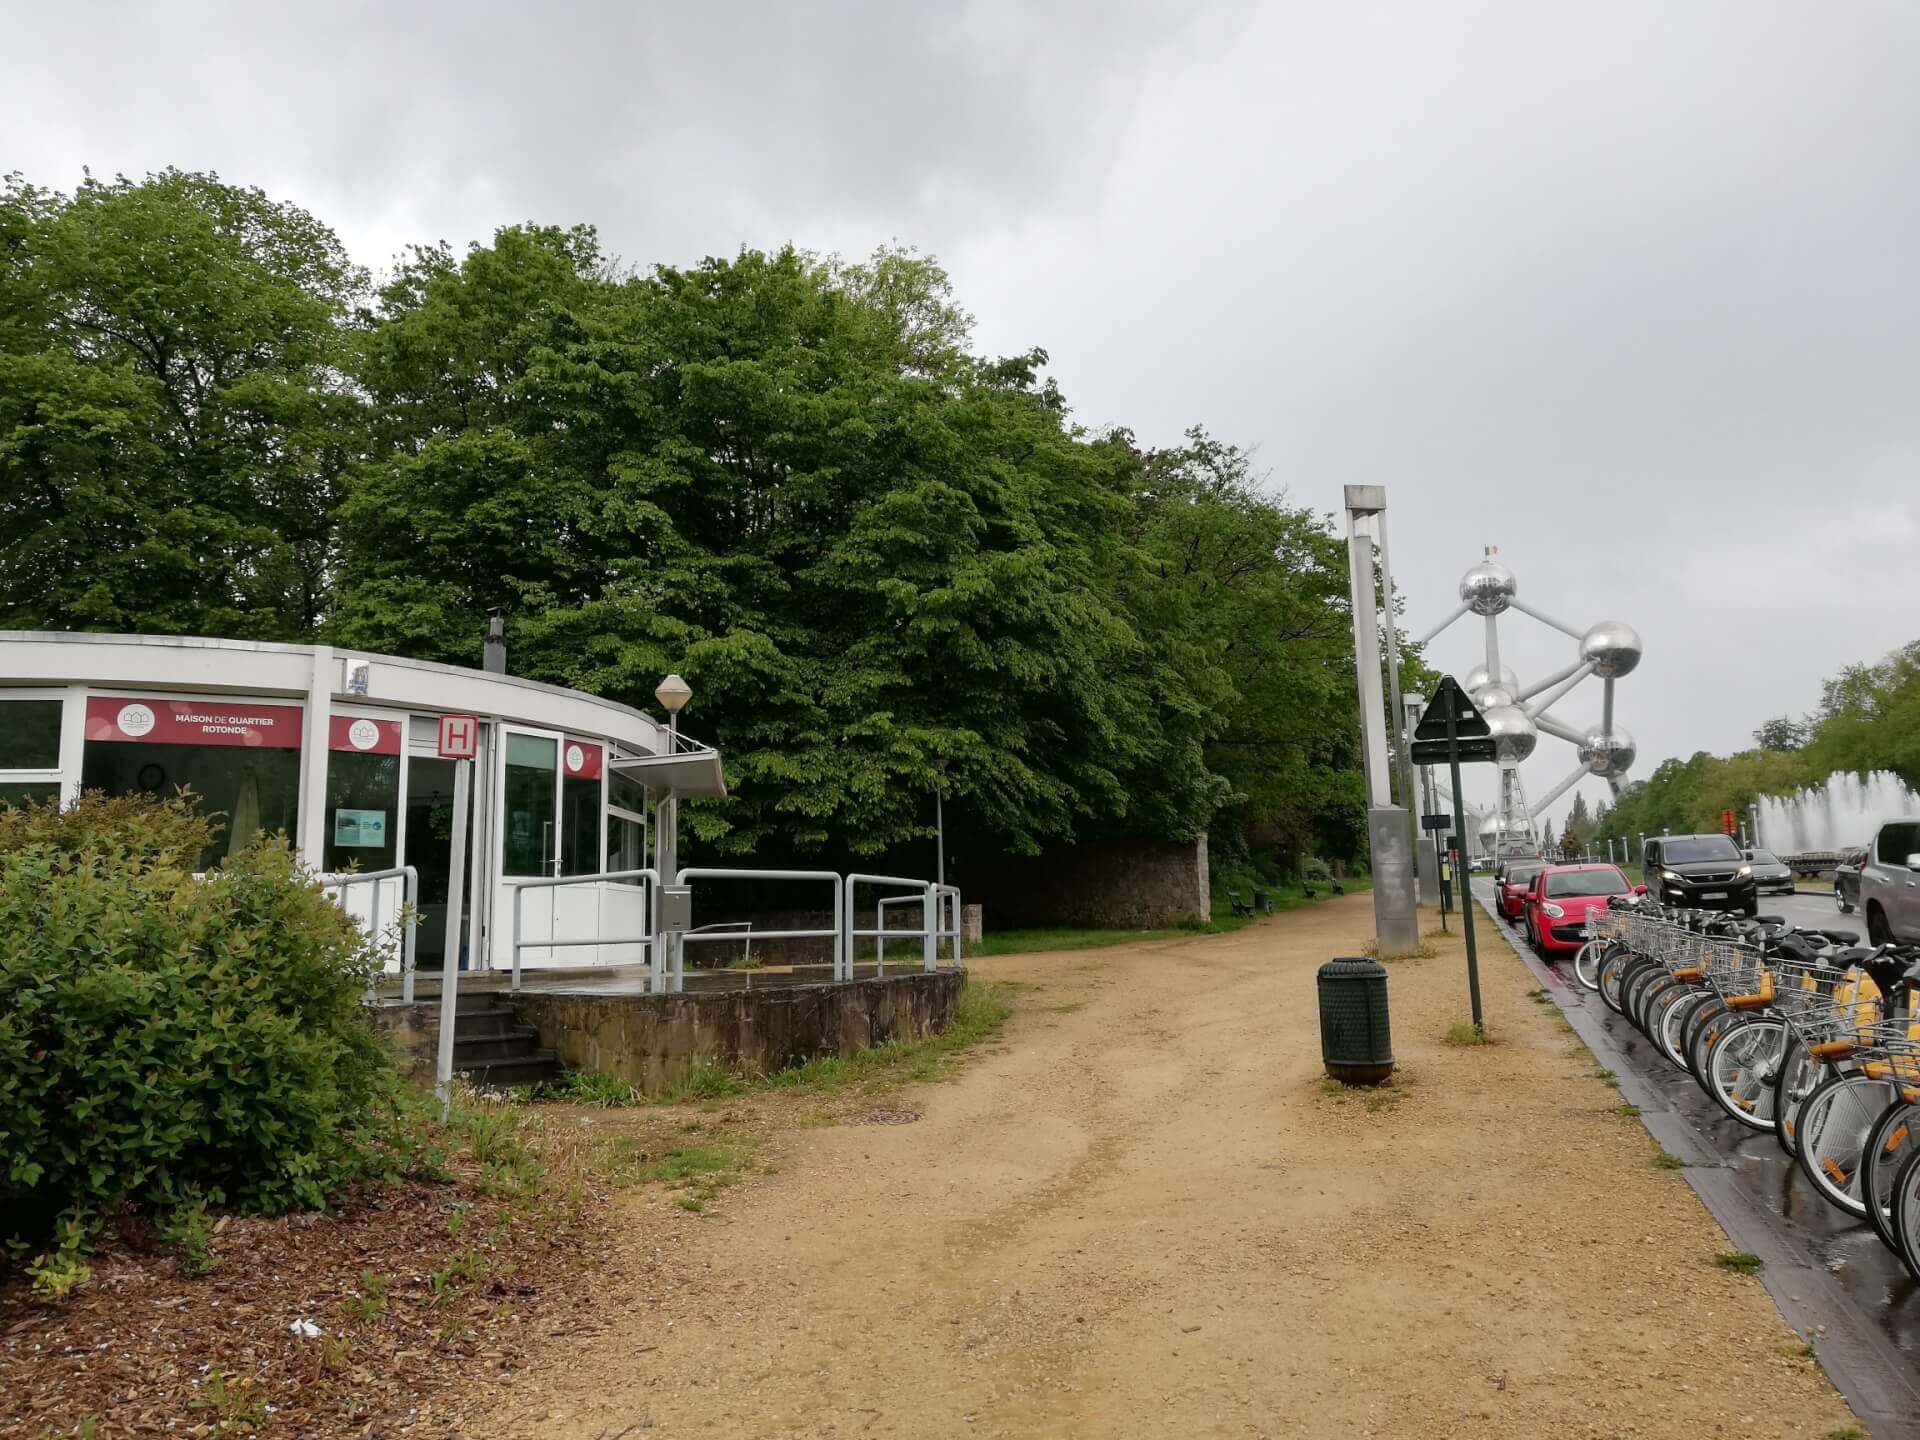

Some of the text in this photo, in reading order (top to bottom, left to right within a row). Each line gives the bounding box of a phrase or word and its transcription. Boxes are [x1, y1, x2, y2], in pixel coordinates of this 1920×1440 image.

[175, 714, 273, 726] MAISON DE QUARTIER
[202, 725, 247, 735] ROTONDE
[448, 723, 467, 749] H
